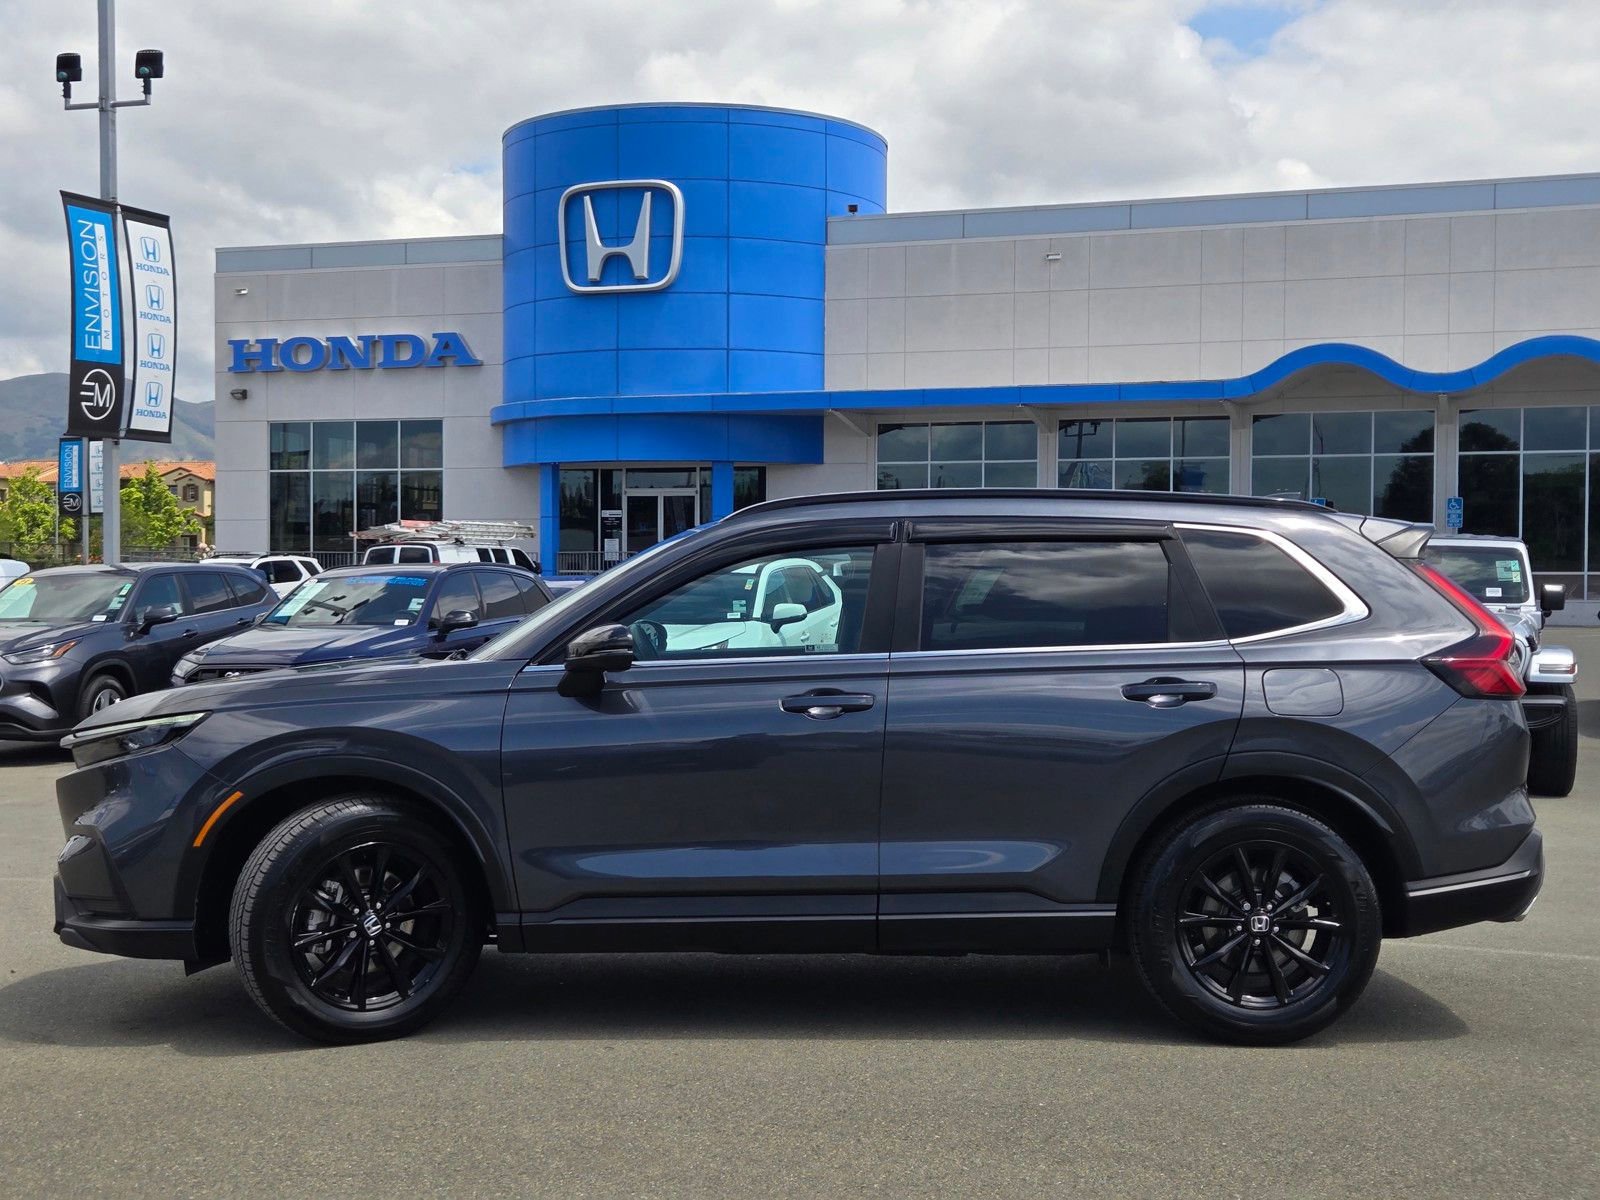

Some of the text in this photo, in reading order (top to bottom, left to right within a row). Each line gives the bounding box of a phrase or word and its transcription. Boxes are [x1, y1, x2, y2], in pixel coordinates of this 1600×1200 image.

[135, 262, 170, 276] HONDA
[77, 219, 101, 350] ENVISION
[99, 234, 111, 340] MOTORS
[139, 311, 172, 324] HONDA
[139, 360, 171, 372] HONDA
[227, 331, 483, 373] HONDA
[135, 408, 168, 420] HONDA
[63, 444, 73, 489] ENVISION
